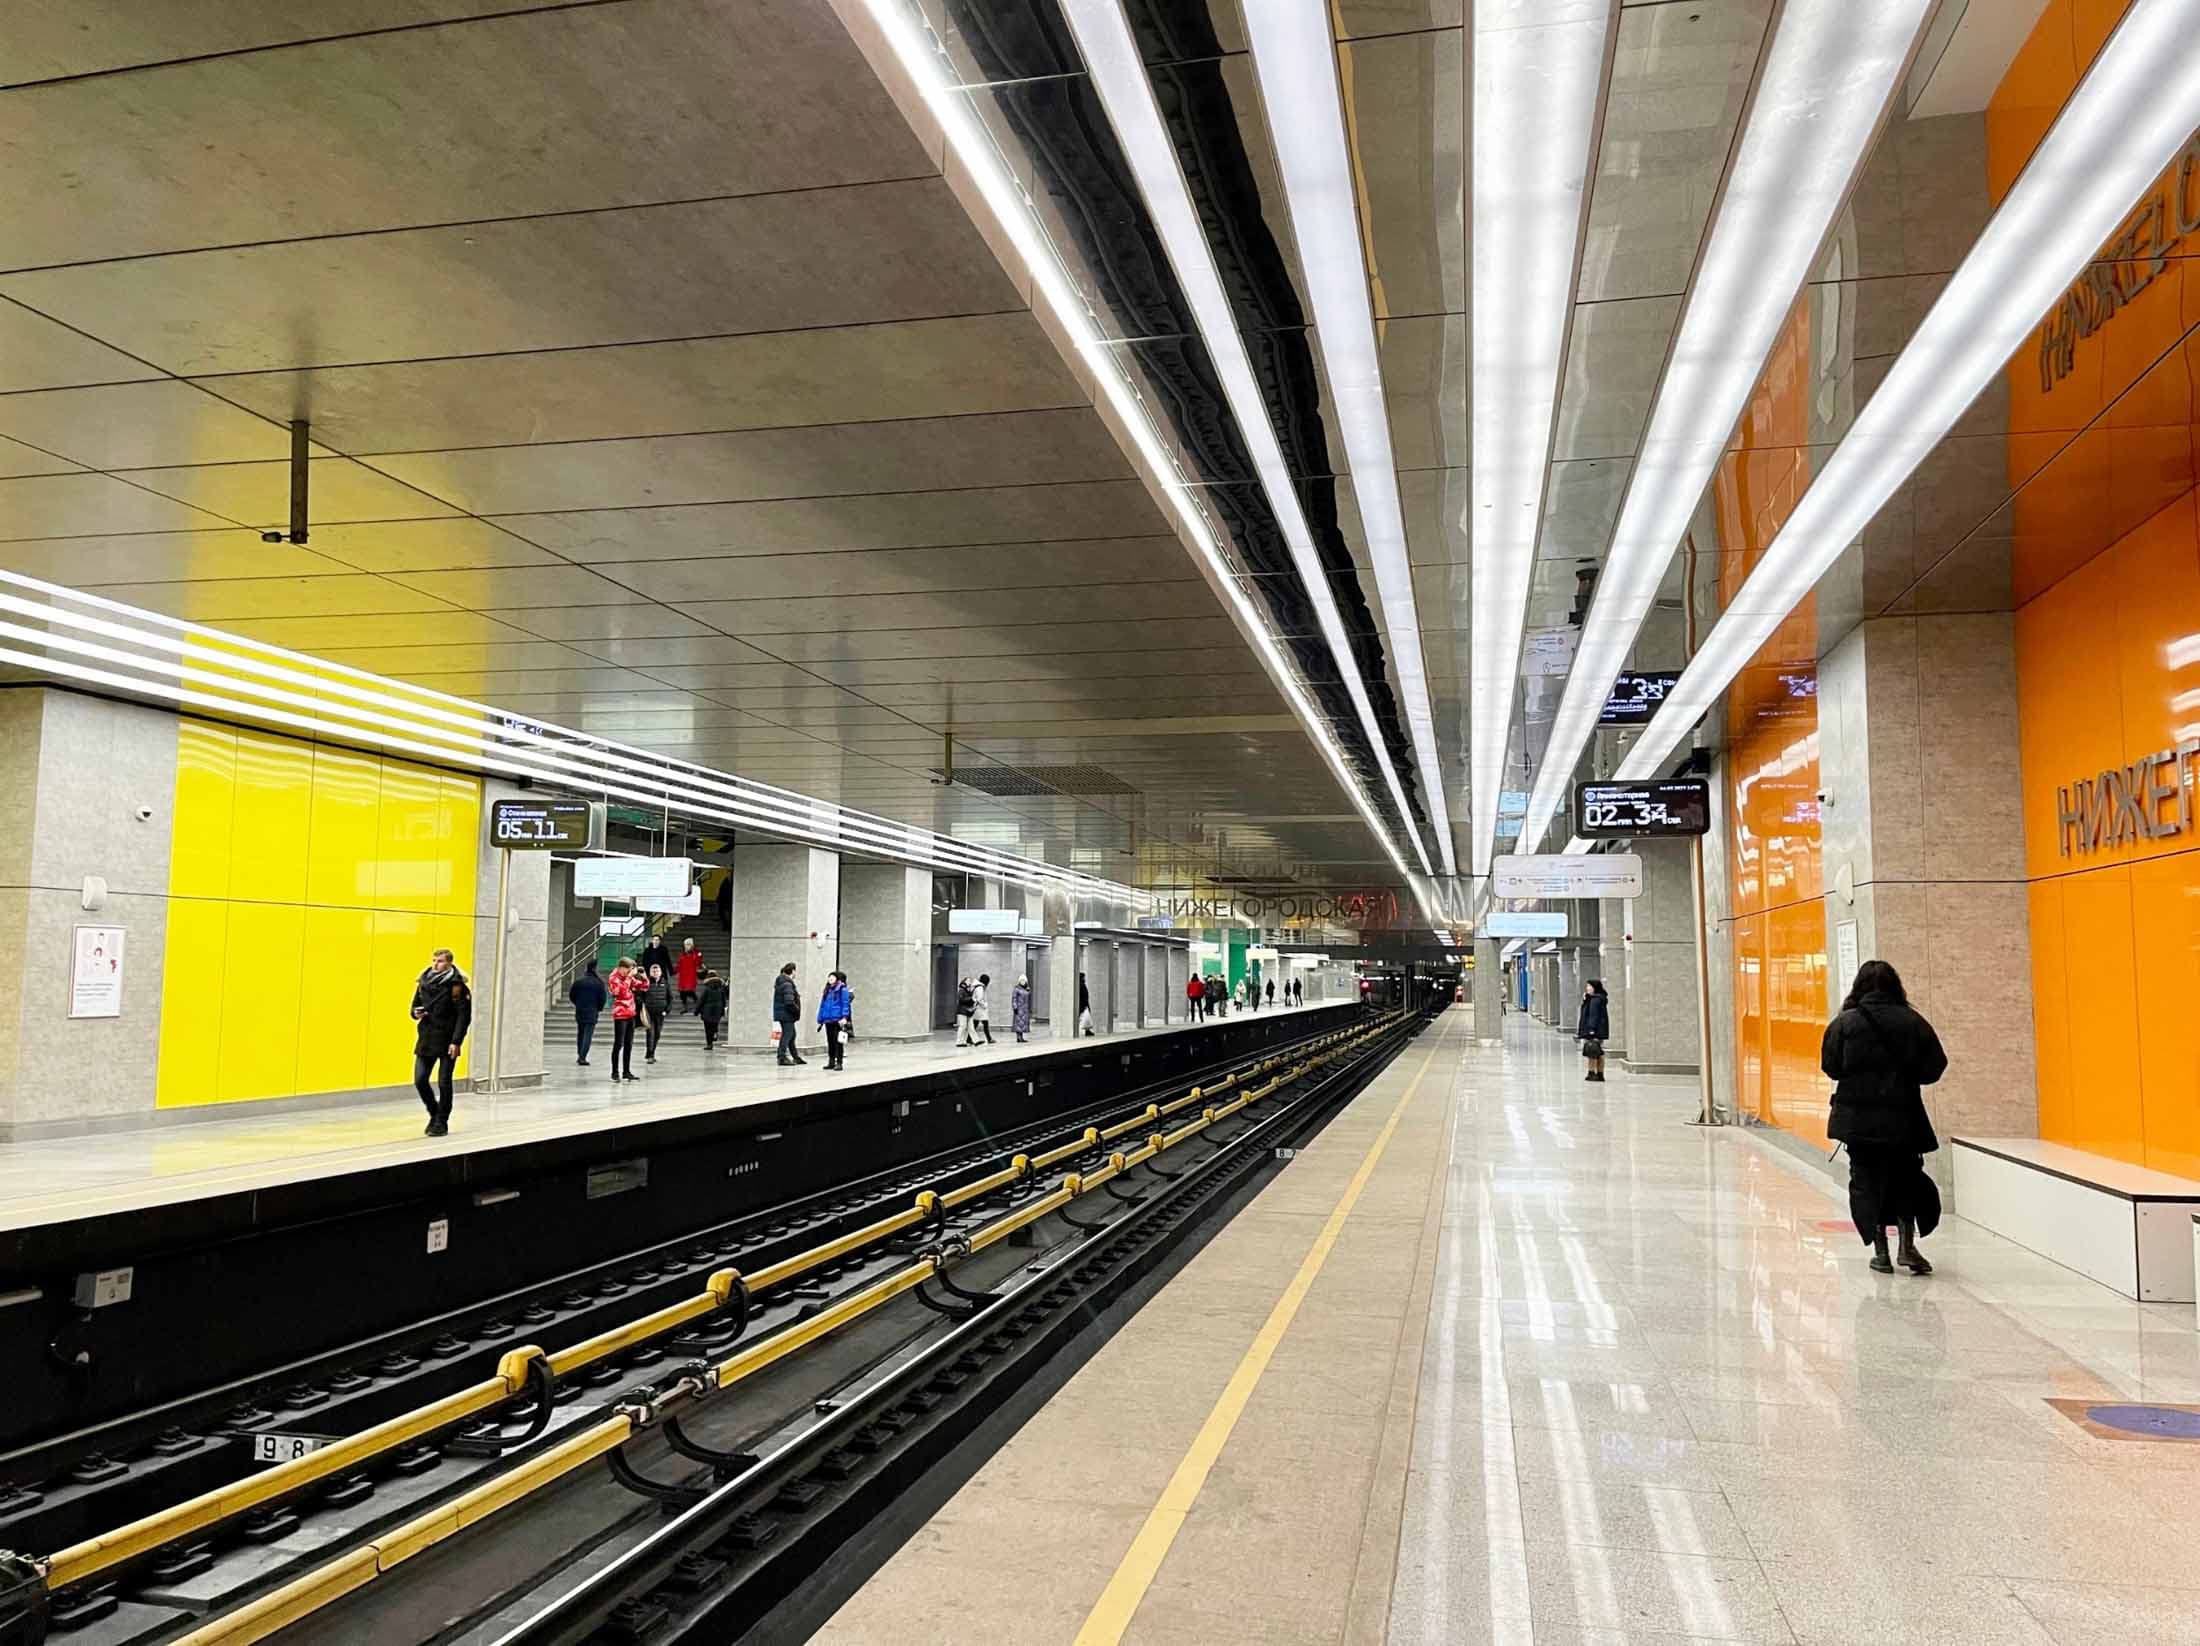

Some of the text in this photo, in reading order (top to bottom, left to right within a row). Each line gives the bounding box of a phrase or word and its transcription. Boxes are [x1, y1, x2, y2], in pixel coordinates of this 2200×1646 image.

[1584, 806, 1617, 826] 02
[498, 821, 522, 839] 05
[534, 821, 558, 839] 11
[1157, 897, 1379, 920] НИЖЕГОРОДСКАЯ
